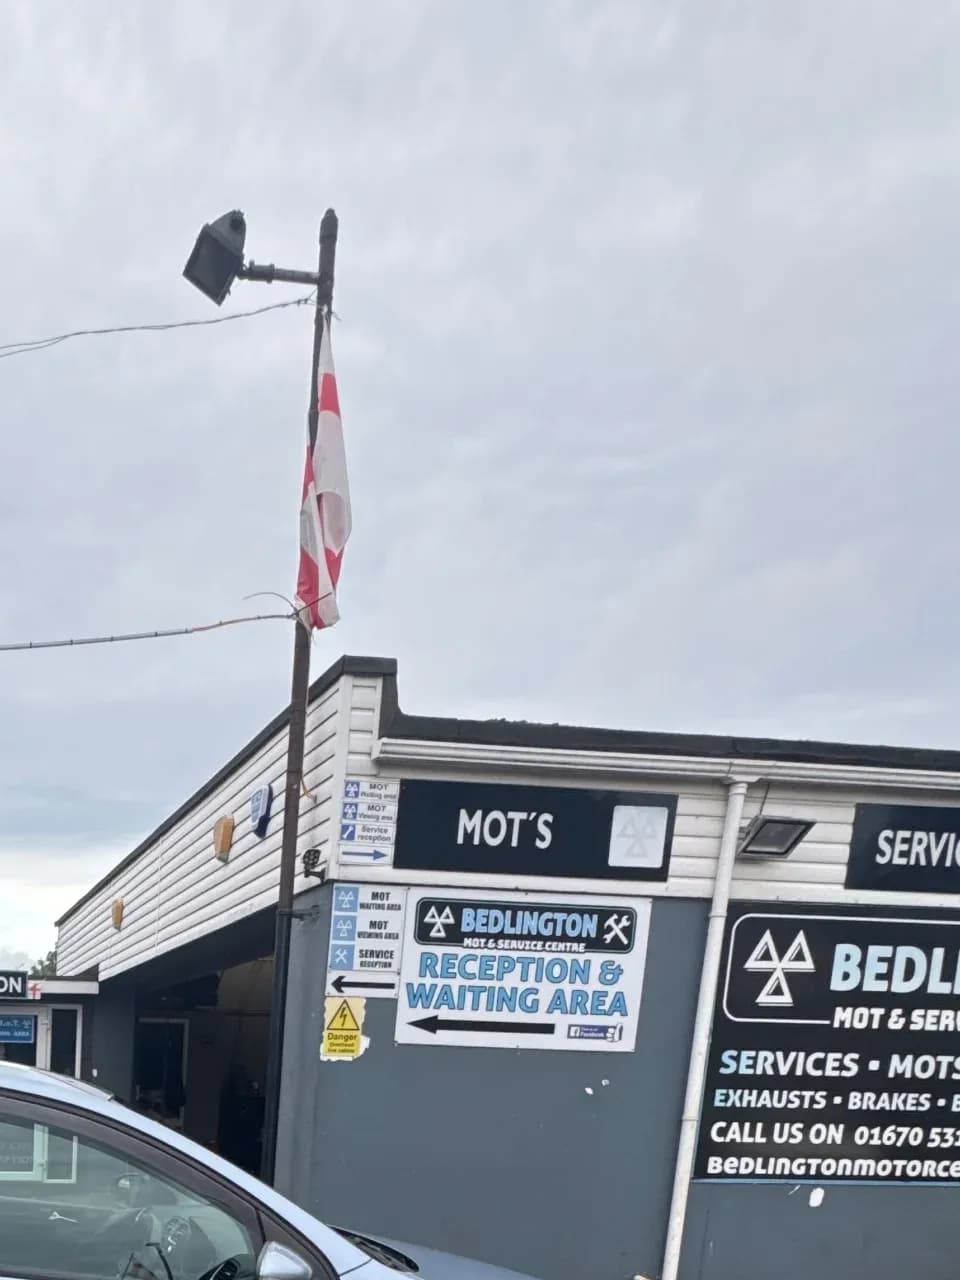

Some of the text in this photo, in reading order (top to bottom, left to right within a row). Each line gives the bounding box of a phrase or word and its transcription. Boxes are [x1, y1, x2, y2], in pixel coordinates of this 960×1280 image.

[456, 808, 554, 850] MOT'S
[875, 829, 960, 868] SERVI
[371, 891, 391, 901] MOT
[369, 920, 388, 930] MOT
[461, 907, 598, 938] BEDLINGTON
[359, 949, 394, 959] SERVICE
[463, 937, 483, 948] MOT
[498, 939, 543, 950] SERVICE
[545, 941, 586, 952] CENTRE
[418, 952, 624, 986] RECEPTION &
[406, 982, 628, 1017] WAITING AREA
[833, 1006, 960, 1032] MOT & SER
[327, 1033, 357, 1042] Danger
[719, 1049, 860, 1077] SERVICES
[713, 1089, 827, 1109] EXHAUSTS
[848, 1091, 932, 1111] BRAKES
[710, 1121, 767, 1143] CALL
[773, 1122, 804, 1144] US
[809, 1123, 845, 1145] ON
[854, 1125, 923, 1147] 01670
